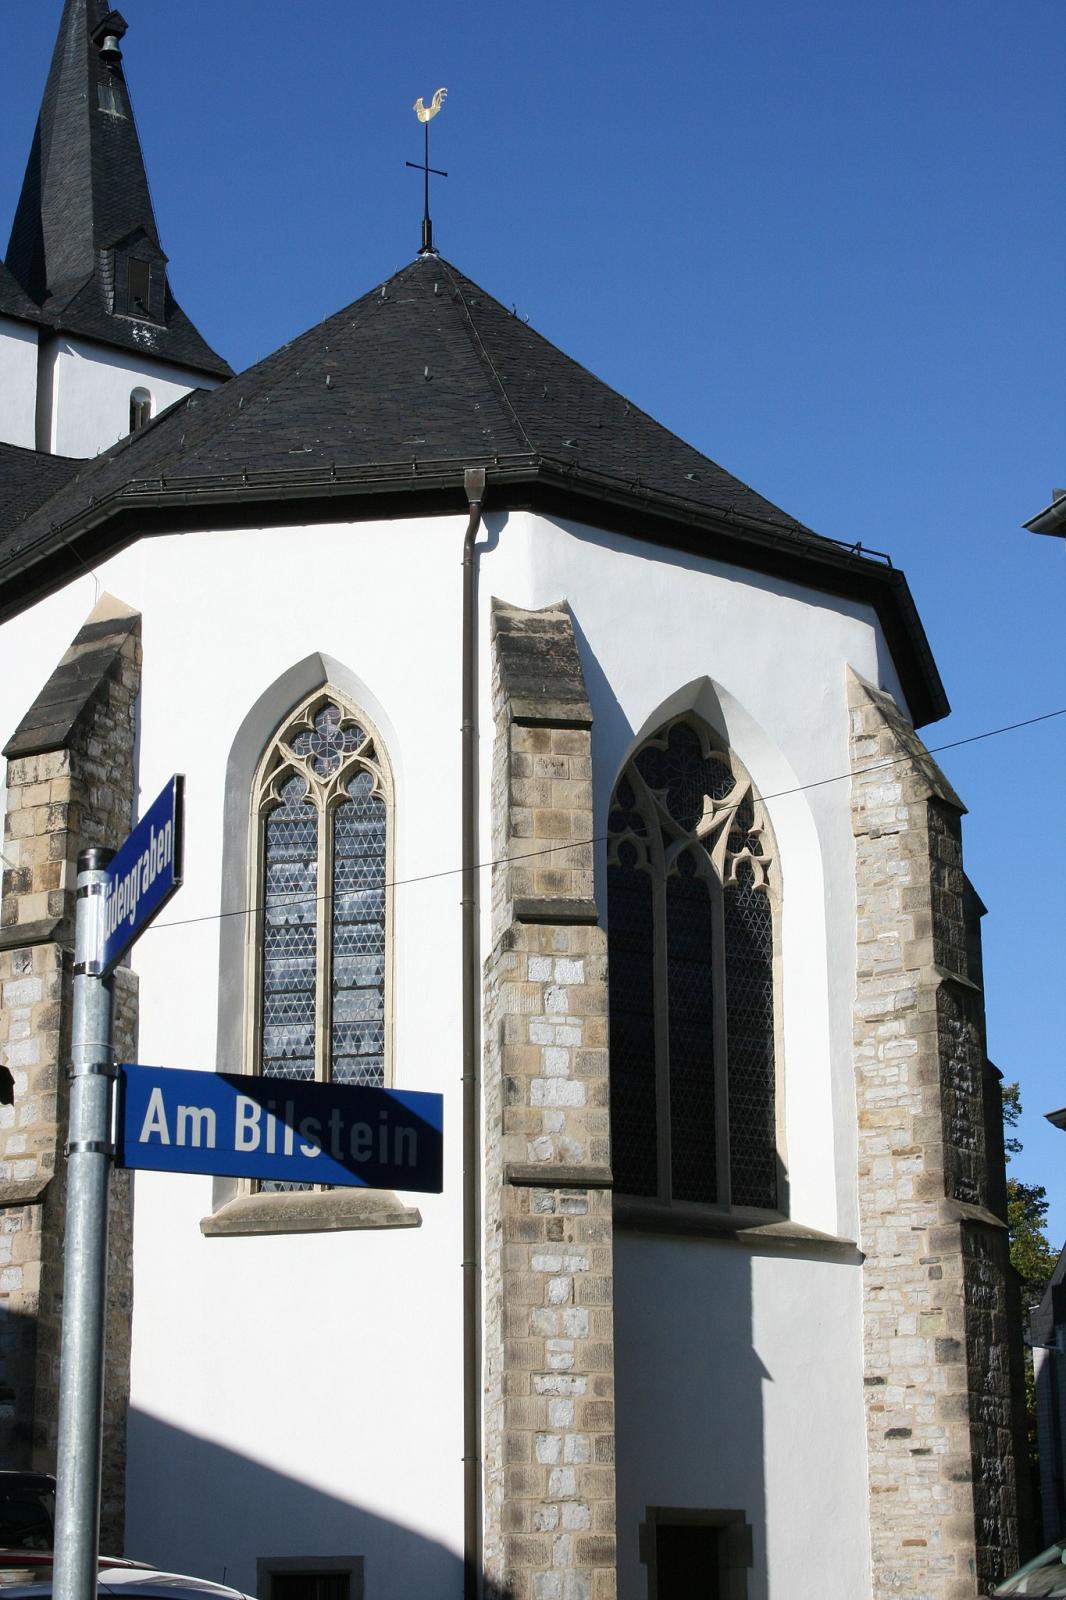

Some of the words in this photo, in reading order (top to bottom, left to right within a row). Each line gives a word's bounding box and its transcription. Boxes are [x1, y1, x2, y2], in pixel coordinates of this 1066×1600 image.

[104, 820, 172, 941] üdengraben
[138, 1087, 216, 1149] Am
[235, 1095, 417, 1167] Bilstein
